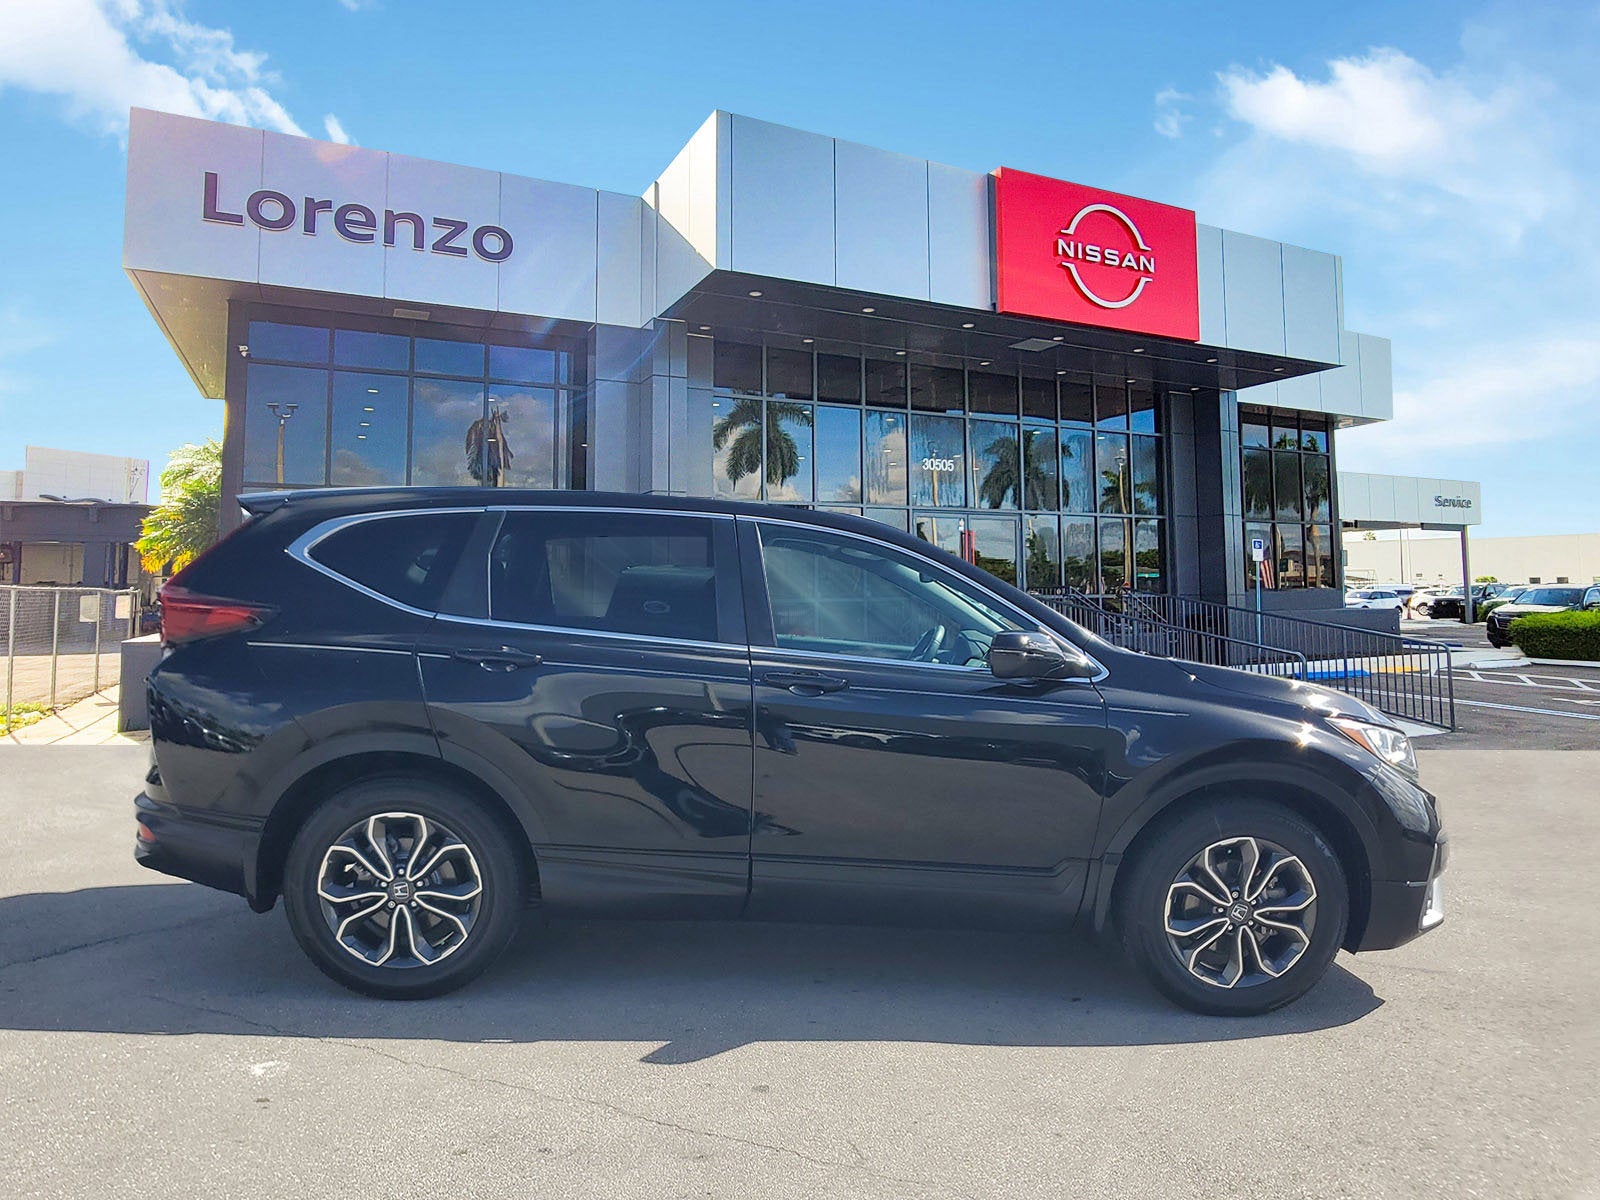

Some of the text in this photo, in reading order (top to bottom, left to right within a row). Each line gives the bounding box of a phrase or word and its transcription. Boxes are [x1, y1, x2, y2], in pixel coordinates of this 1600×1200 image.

[202, 171, 514, 263] Lorenzo
[1057, 238, 1155, 273] NISSAN
[922, 458, 955, 472] 30505
[1434, 495, 1472, 509] Service
